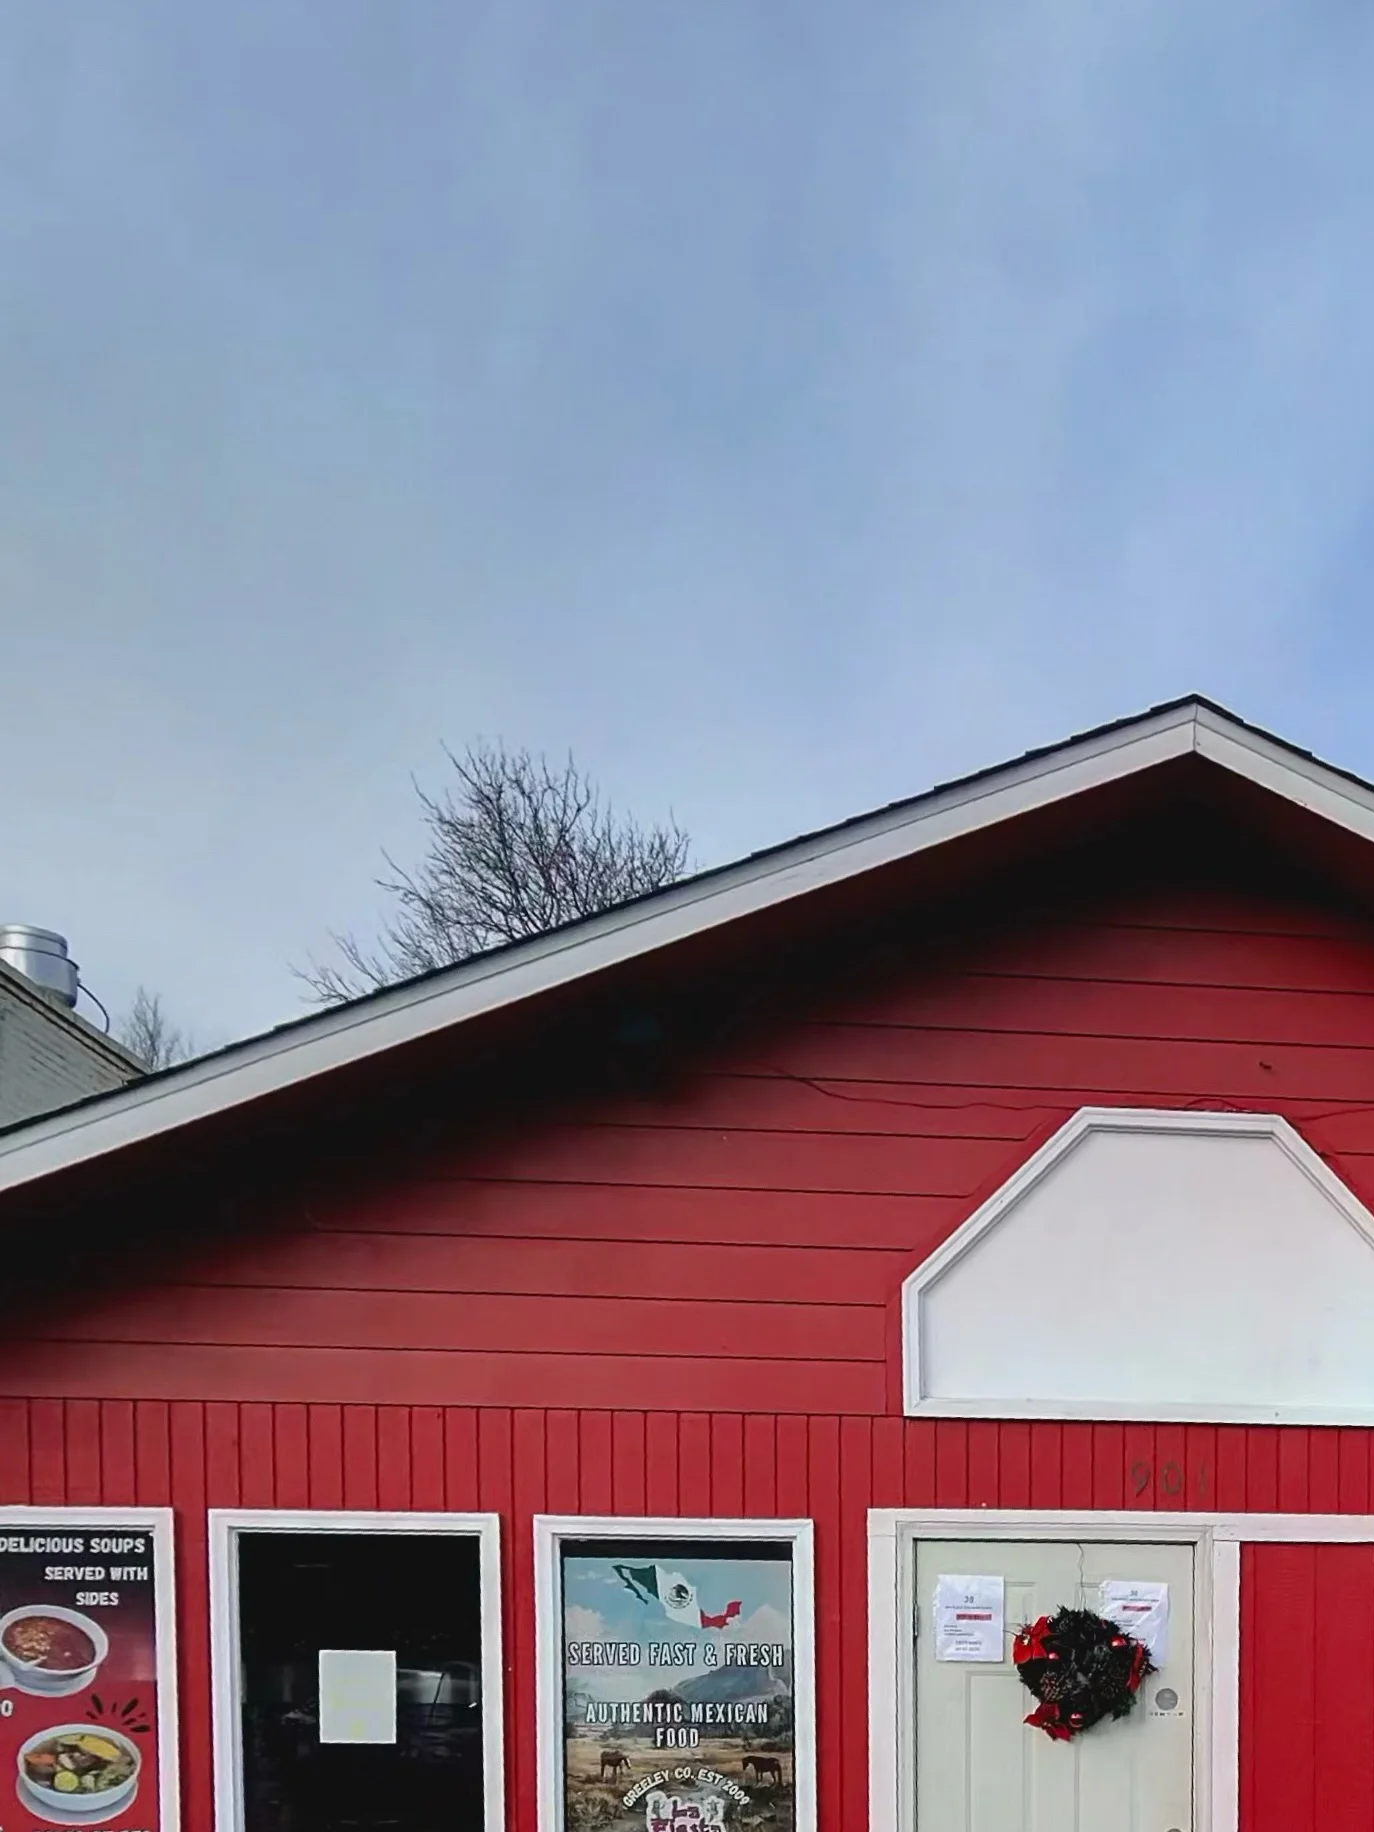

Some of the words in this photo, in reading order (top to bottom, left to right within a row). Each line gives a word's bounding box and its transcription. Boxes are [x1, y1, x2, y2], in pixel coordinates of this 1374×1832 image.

[0, 1537, 84, 1553] DELICIOUS
[90, 1538, 145, 1553] SOUPS
[44, 1566, 105, 1580] SERVED
[110, 1567, 148, 1580] WITH
[76, 1592, 119, 1606] SIDES
[568, 1641, 641, 1666] SERVED
[649, 1643, 698, 1667] FAST
[705, 1645, 718, 1667] &
[725, 1644, 784, 1668] FRESH
[586, 1701, 683, 1725] AUTHENTIC
[691, 1702, 769, 1725] MEXICAN
[655, 1727, 700, 1749] FOOD
[622, 1769, 670, 1808] GREELEY
[697, 1769, 723, 1785] EST
[721, 1781, 751, 1806] 2009
[672, 1799, 700, 1819] La
